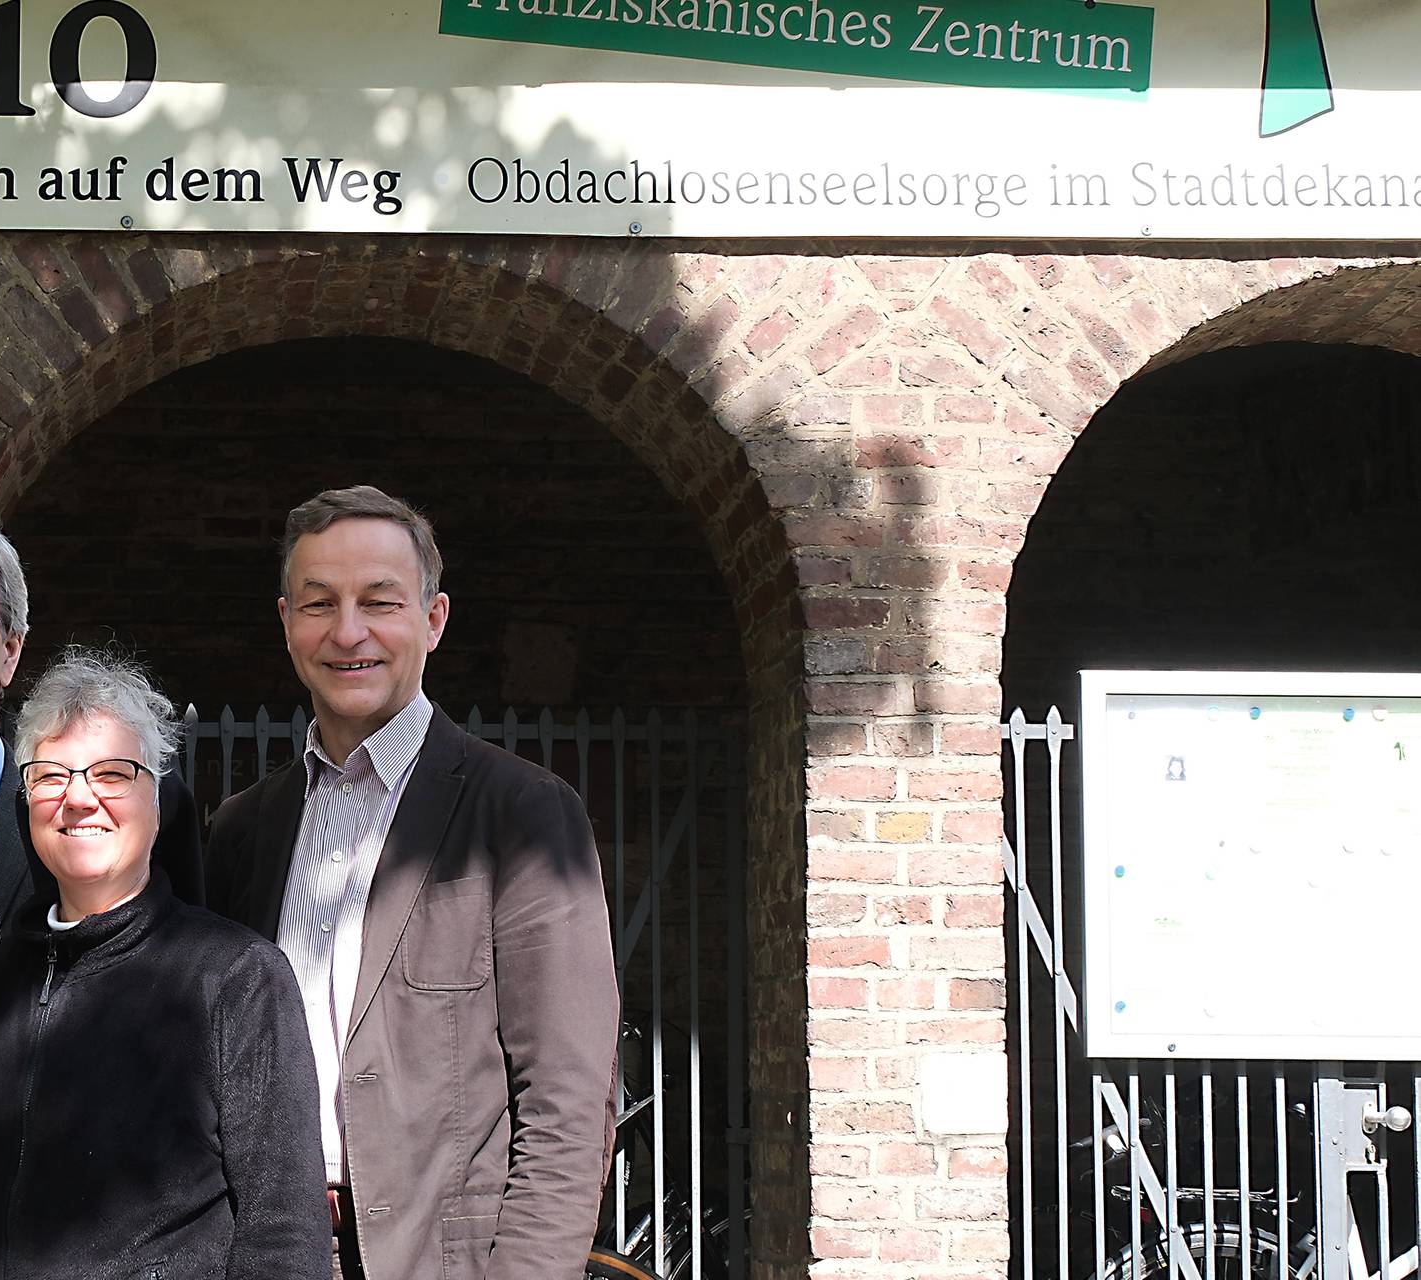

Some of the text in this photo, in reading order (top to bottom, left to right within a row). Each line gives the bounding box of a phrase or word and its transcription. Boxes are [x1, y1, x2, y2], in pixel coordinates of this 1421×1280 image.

[467, 0, 1132, 72] nzskanisches Zentrum
[38, 156, 129, 201] auf
[145, 156, 265, 202] dem
[281, 156, 403, 215] Weg
[466, 156, 1027, 218] Obdachlosenseelsorge
[1049, 164, 1111, 206] im
